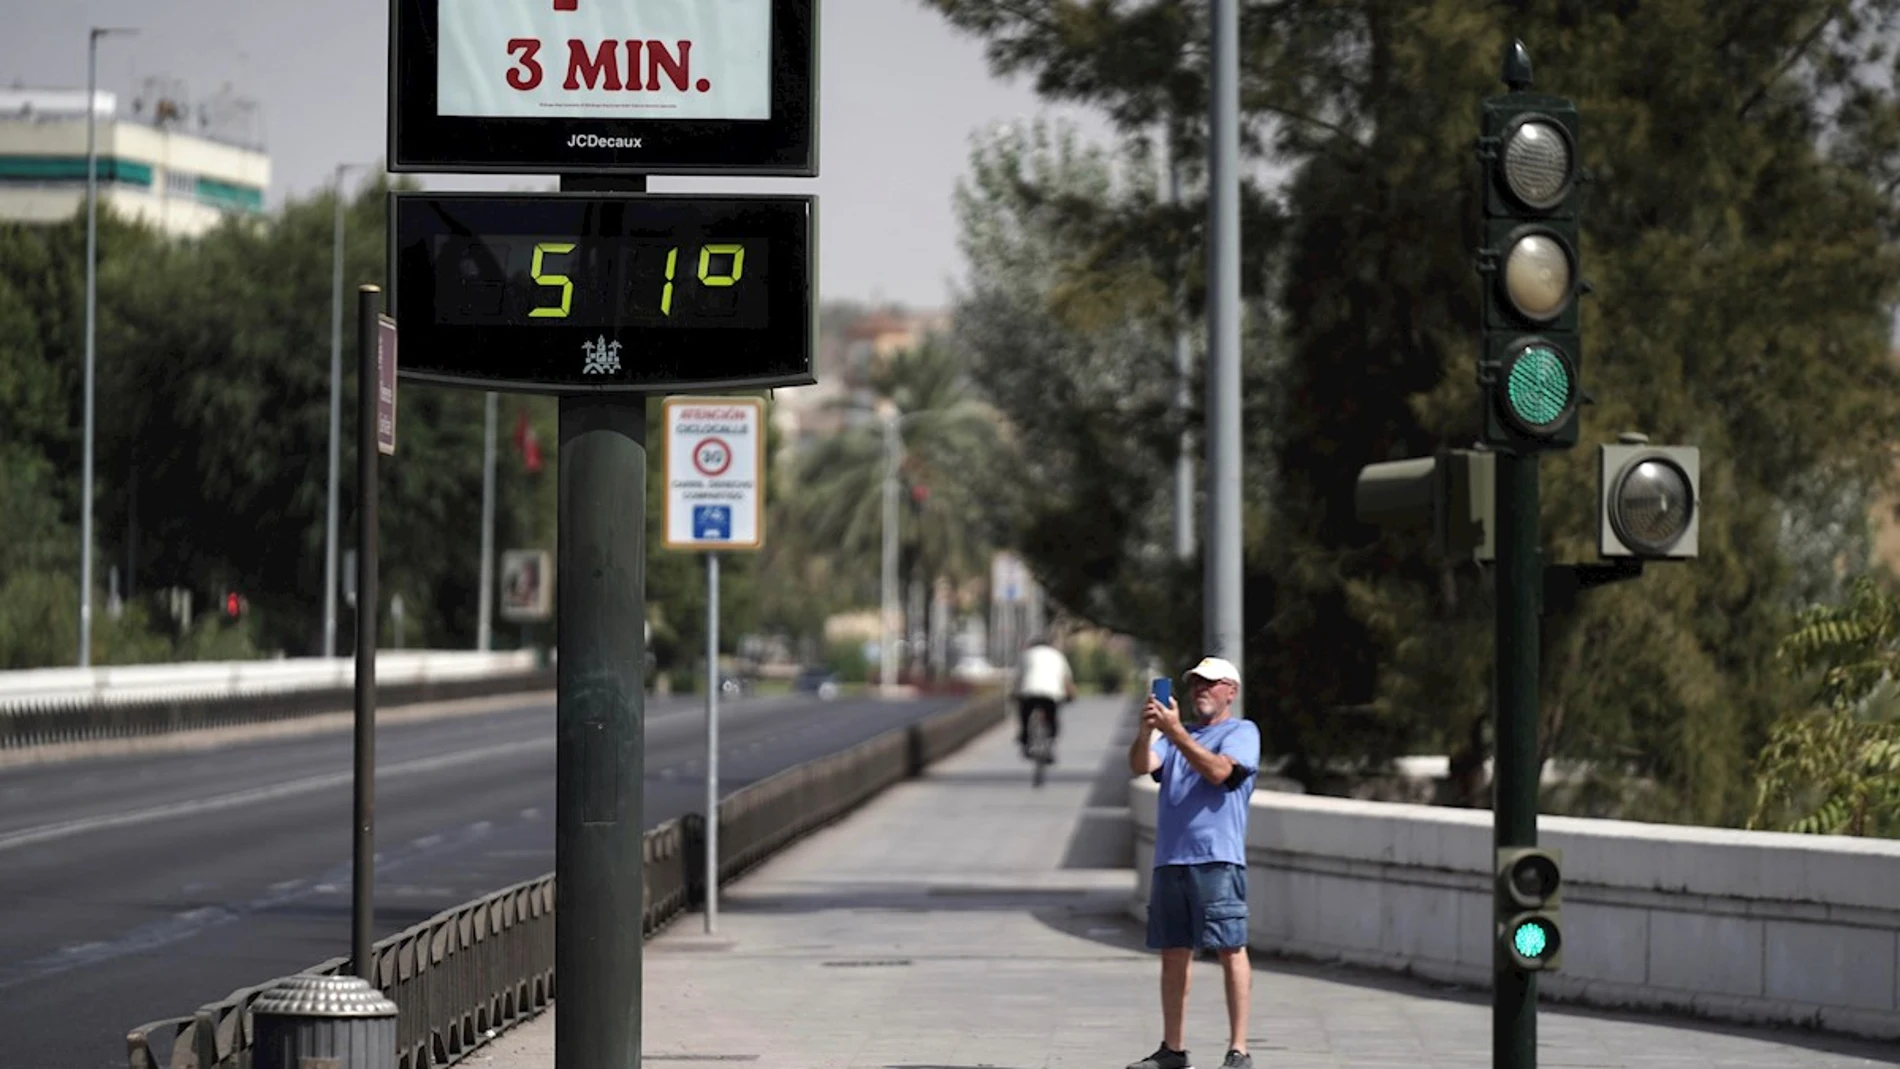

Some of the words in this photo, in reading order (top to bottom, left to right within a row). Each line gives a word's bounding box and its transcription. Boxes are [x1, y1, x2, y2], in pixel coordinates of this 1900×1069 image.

[506, 39, 543, 91] 3
[563, 39, 710, 92] MIN.
[567, 134, 642, 148] JCDecaux
